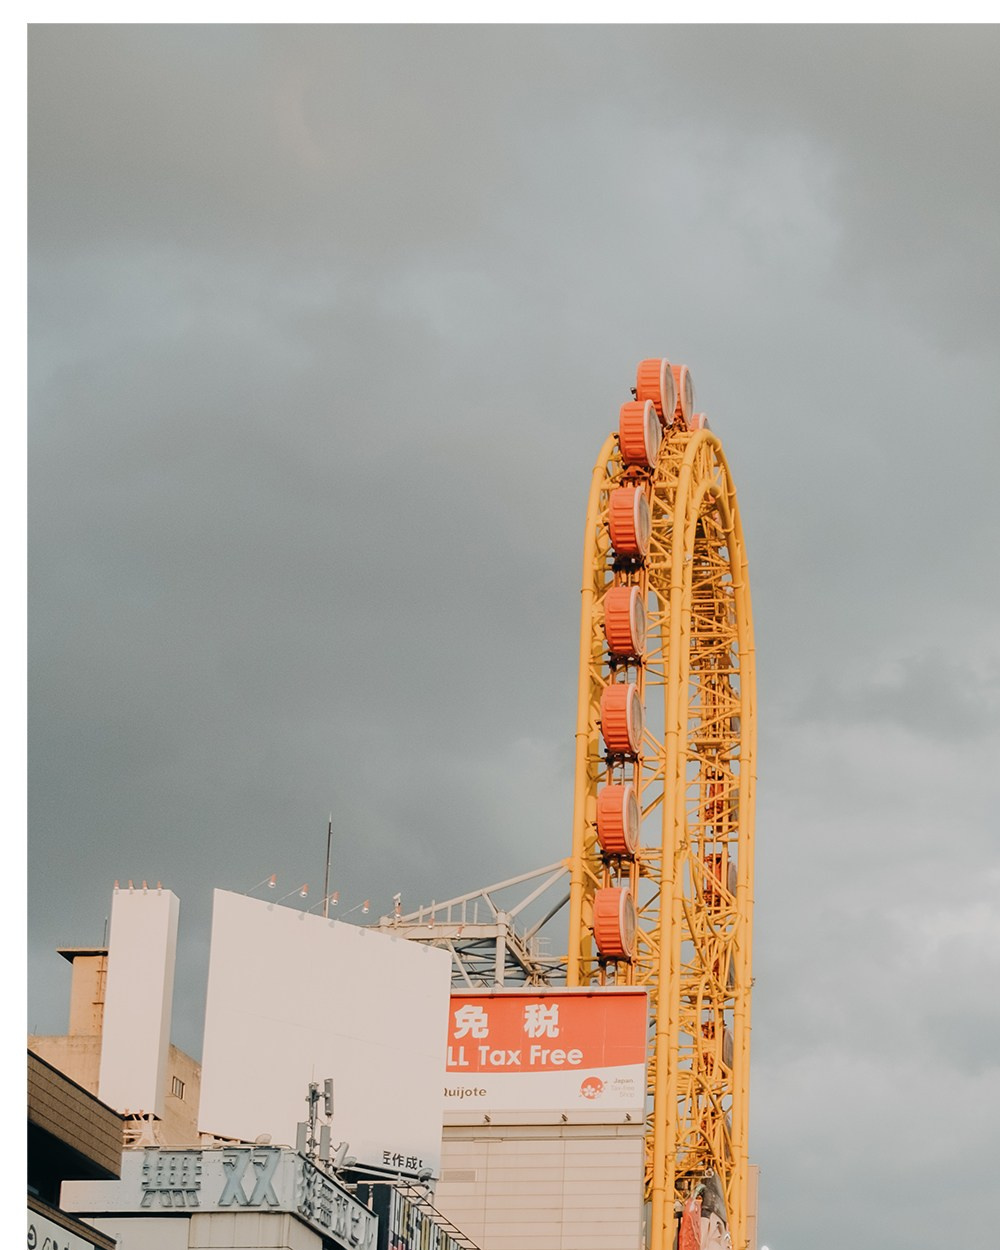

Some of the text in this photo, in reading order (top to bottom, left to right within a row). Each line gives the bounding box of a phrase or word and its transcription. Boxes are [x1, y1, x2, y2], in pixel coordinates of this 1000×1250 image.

[453, 1004, 560, 1039] 免税
[478, 1045, 521, 1066] Tax
[530, 1044, 584, 1065] Free
[140, 1147, 281, 1207] 無双
